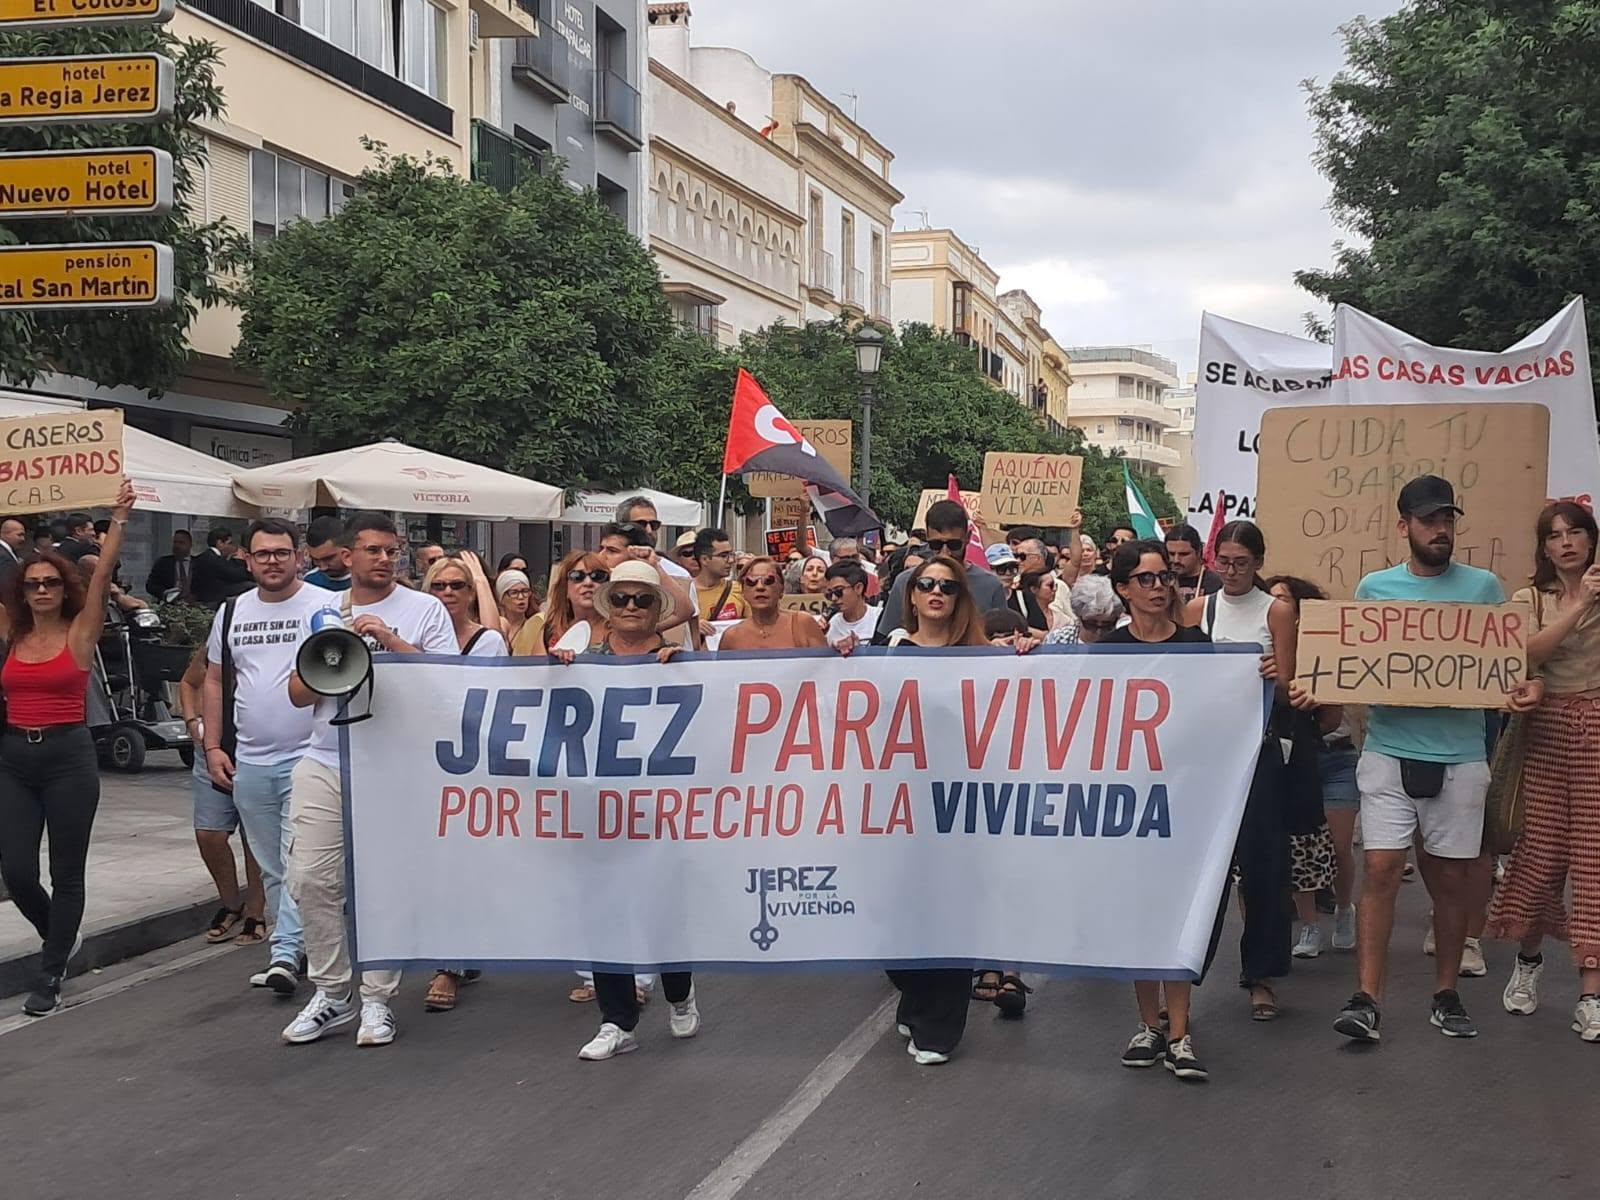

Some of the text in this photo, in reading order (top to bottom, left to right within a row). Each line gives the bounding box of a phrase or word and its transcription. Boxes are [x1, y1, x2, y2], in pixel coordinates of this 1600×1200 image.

[564, 1, 584, 31] HOTEL
[557, 20, 592, 60] TRAFALGAR
[62, 66, 106, 82] hotel
[20, 86, 83, 109] Regia
[92, 84, 150, 104] Jerez
[87, 161, 131, 176] hotel
[0, 179, 149, 203] Nuevo Hotel
[65, 253, 131, 272] pensión
[32, 277, 74, 298] San
[81, 274, 150, 297] Martín
[1205, 362, 1237, 385] SE
[1377, 357, 1466, 386] CASAS
[1475, 350, 1575, 385] VACÍAS
[6, 420, 104, 450] CASEROS
[1286, 411, 1488, 464] CUIDA TU
[0, 449, 121, 483] BASTARDS
[413, 493, 471, 503] VICTORIA
[990, 478, 1071, 495] HAY QUIEN
[995, 496, 1045, 517] VIVA
[243, 621, 268, 632] GENTE
[269, 620, 285, 630] SIN
[241, 635, 264, 645] CASA
[265, 634, 281, 644] SIN
[435, 678, 1171, 777] JEREZ PARA VIVIR
[438, 781, 1172, 840] POR EL DERECHO A LA VIVIENDA
[745, 866, 838, 893] JEREZ
[799, 892, 839, 900] POR LA
[768, 900, 855, 917] VIVIENDA
